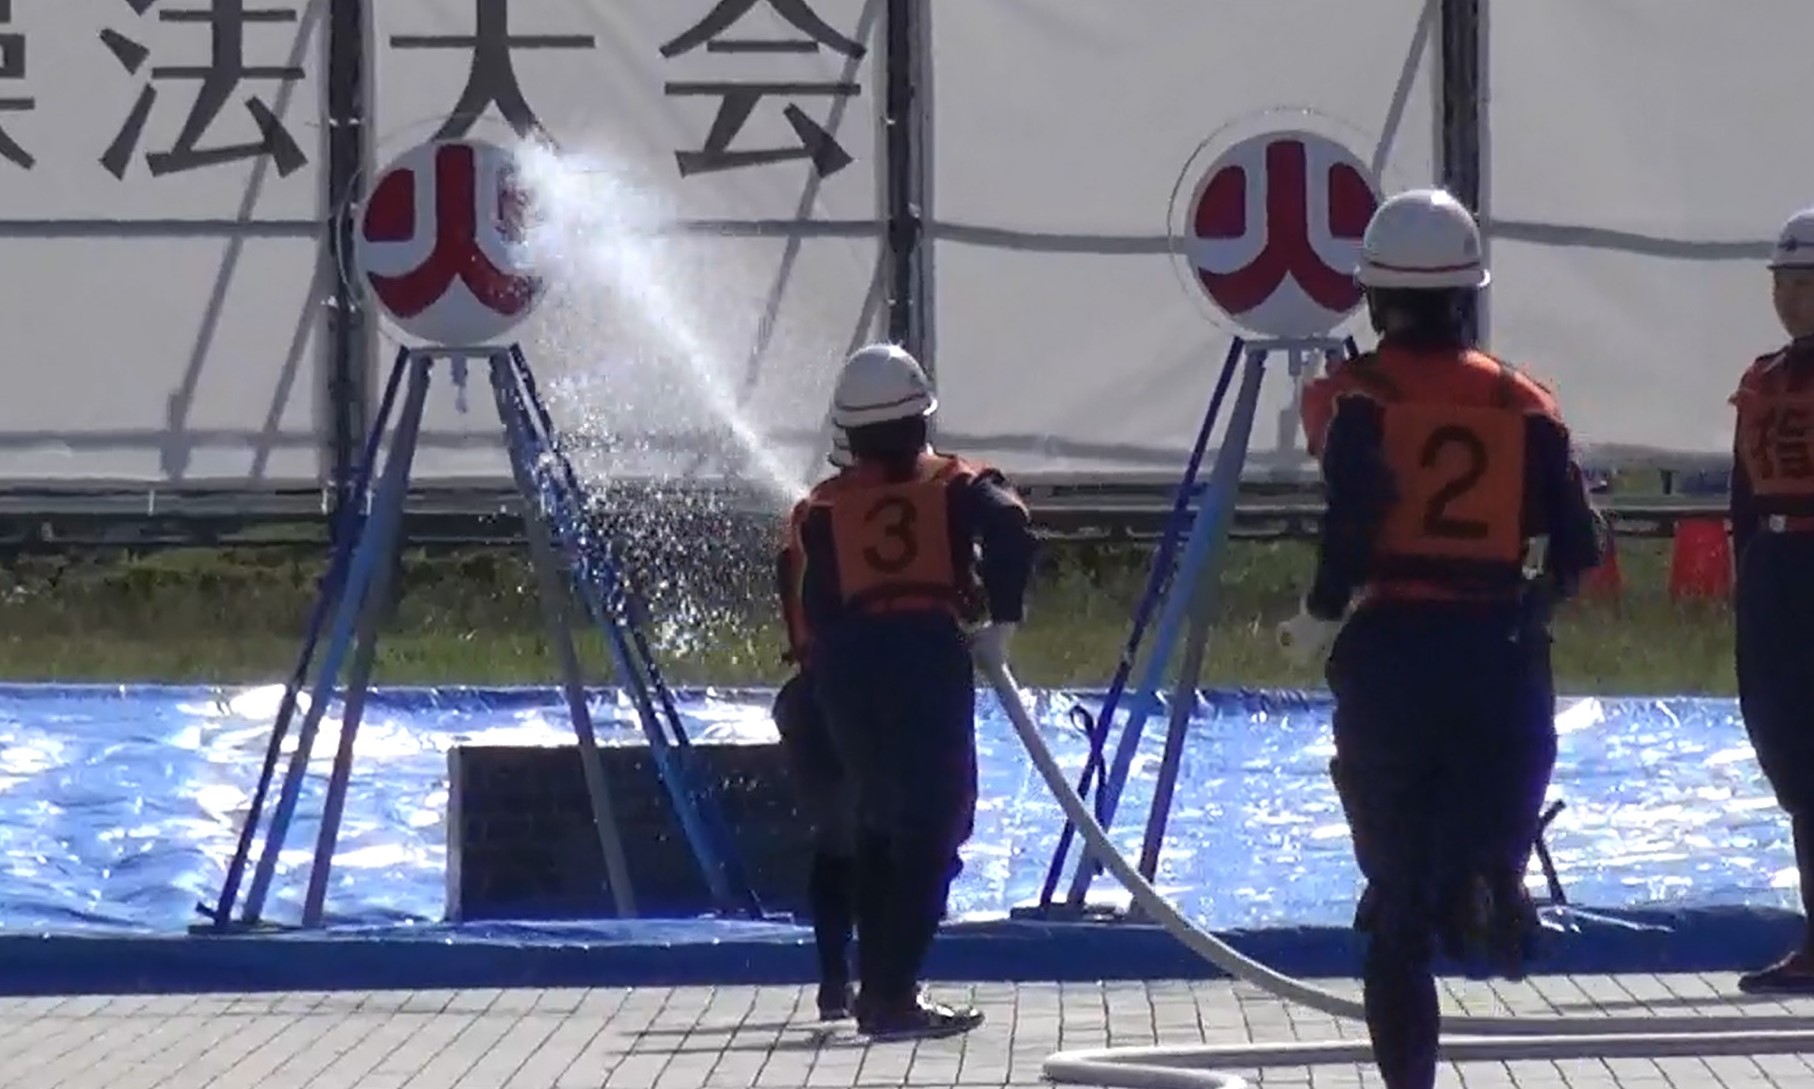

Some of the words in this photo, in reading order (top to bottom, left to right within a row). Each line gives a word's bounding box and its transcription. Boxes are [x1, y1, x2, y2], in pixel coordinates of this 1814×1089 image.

[0, 0, 866, 180] 法大会
[862, 497, 918, 574] 3
[1420, 425, 1489, 539] 2
